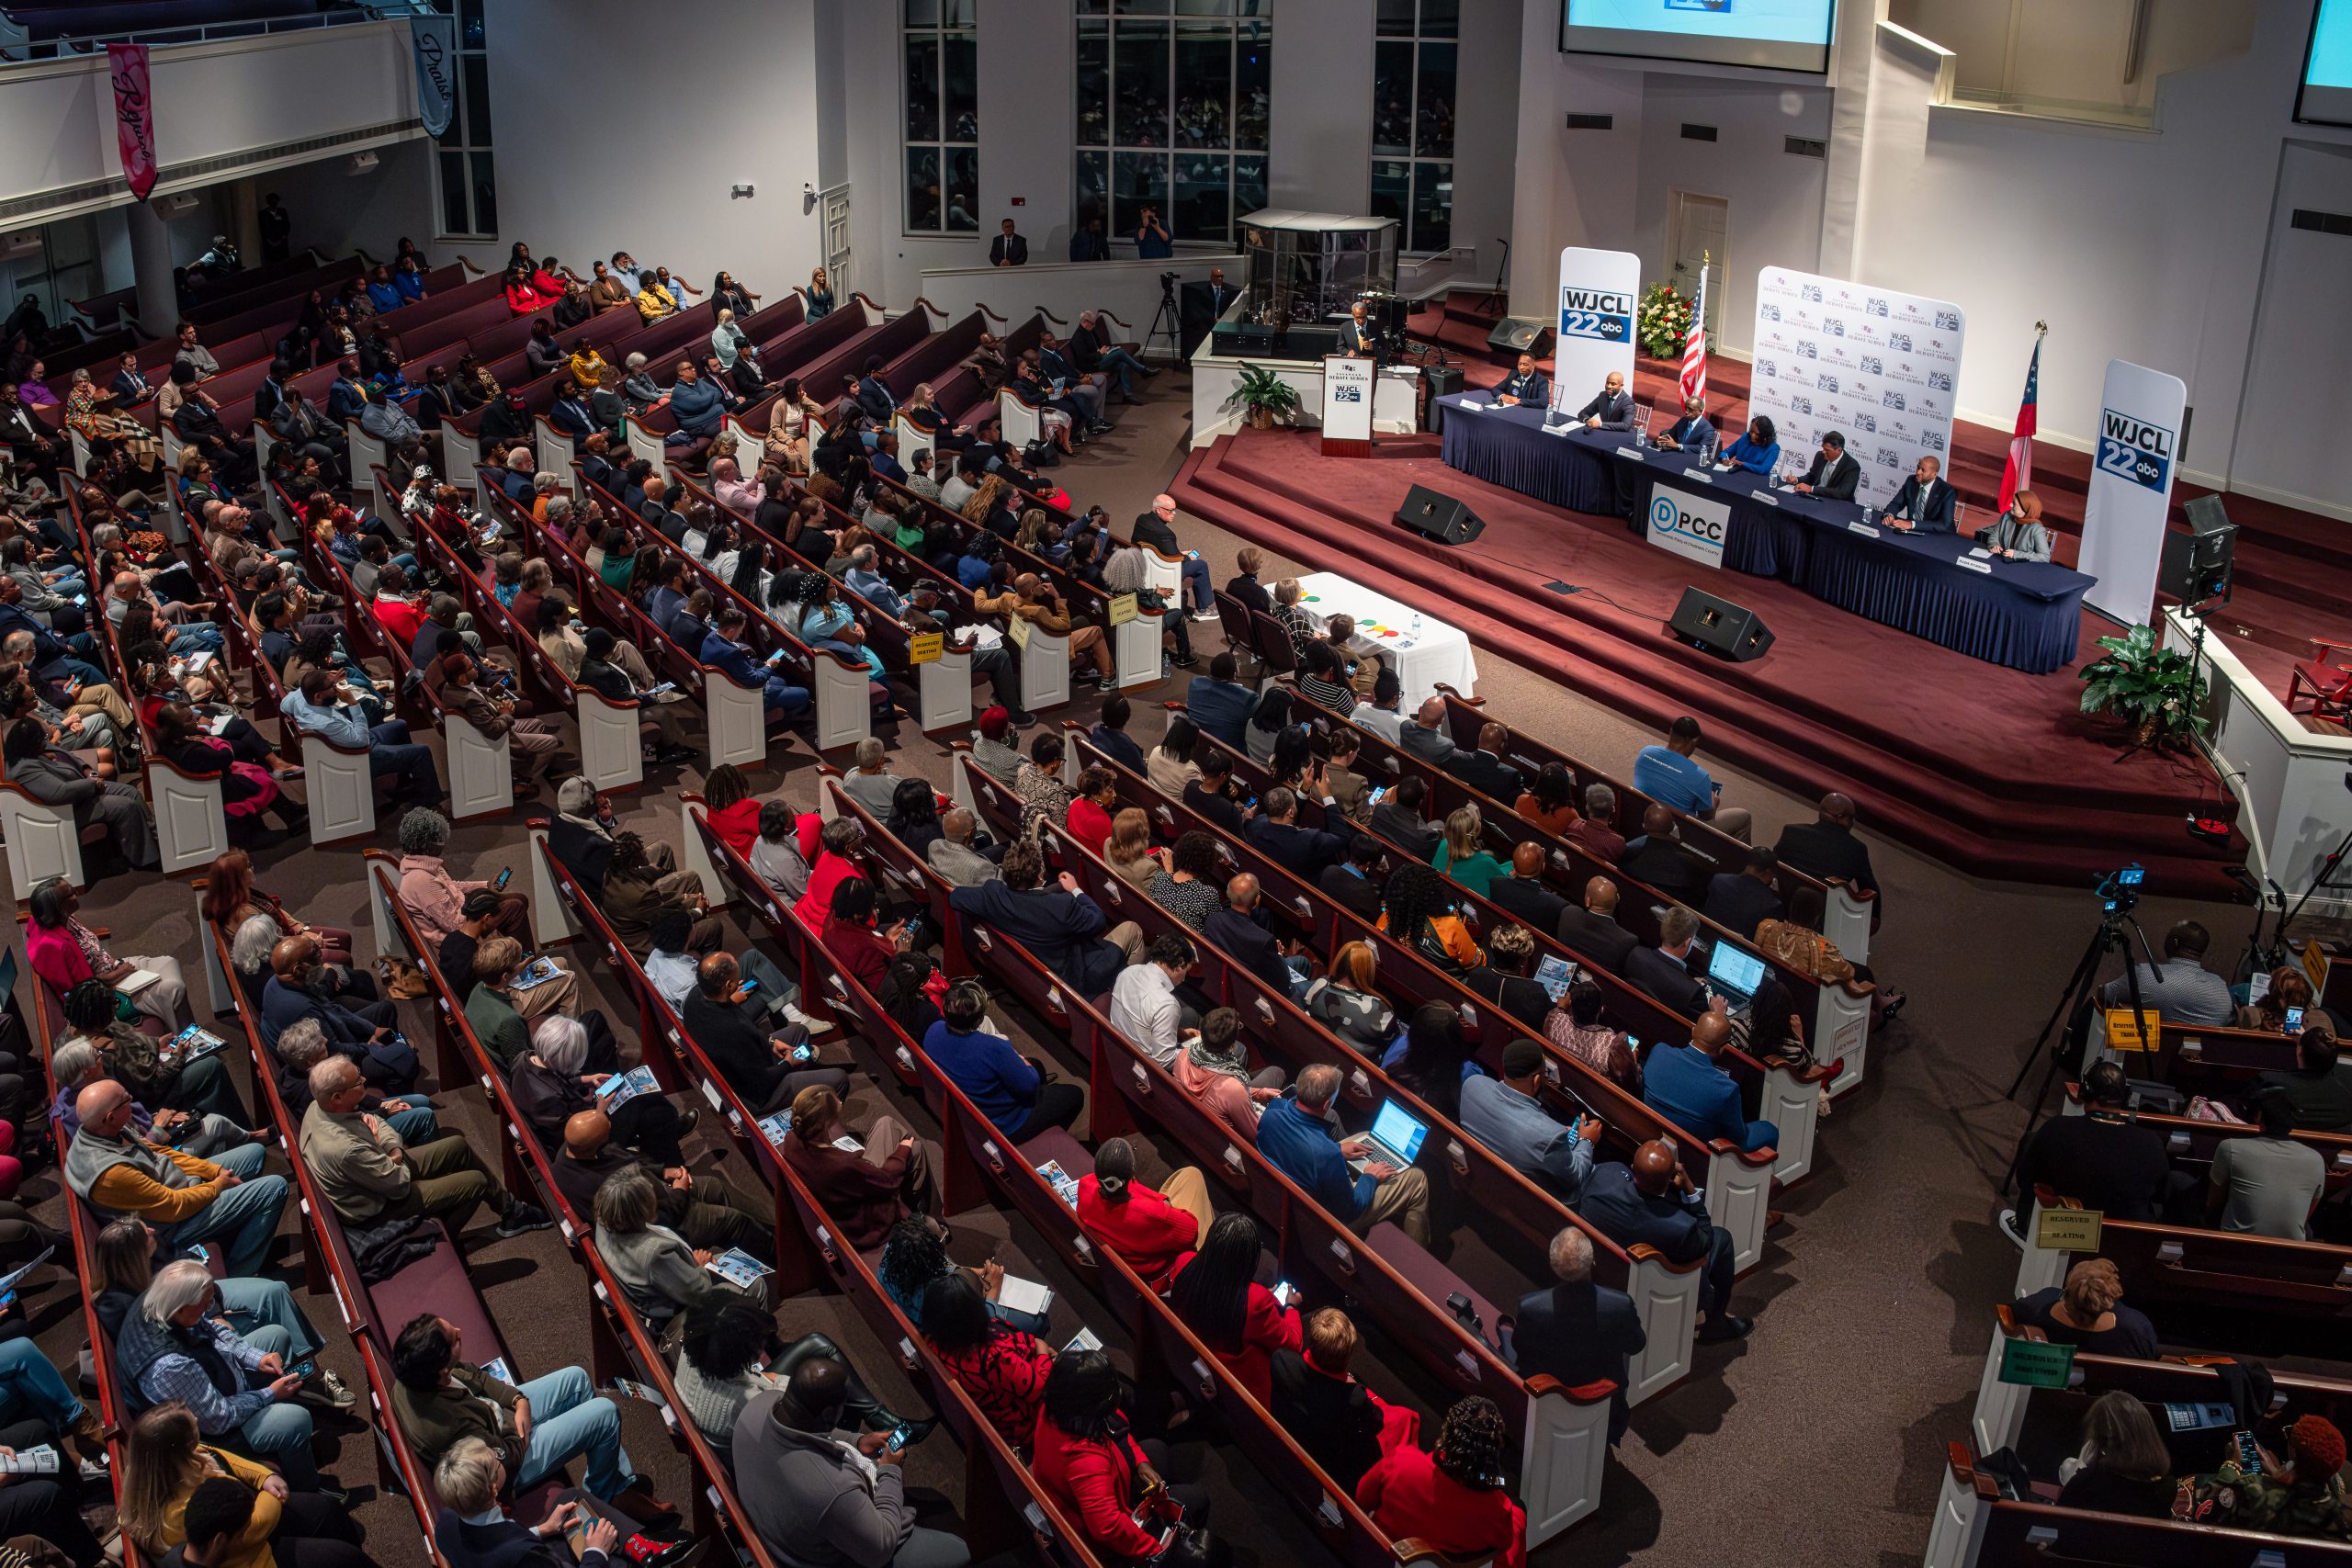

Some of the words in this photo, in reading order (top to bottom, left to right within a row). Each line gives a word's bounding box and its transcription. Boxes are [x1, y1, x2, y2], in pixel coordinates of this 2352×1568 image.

[415, 33, 452, 101] Praise
[1804, 284, 1822, 293] WJCL
[1566, 290, 1629, 315] WJCL
[1762, 303, 1781, 312] WJCL
[1868, 298, 1888, 307] WJCL
[1937, 311, 1959, 321] WJCL
[1566, 311, 1606, 338] 22
[1600, 321, 1623, 333] abc
[1825, 317, 1844, 327] WJCL
[1891, 333, 1912, 342] WJCL
[1798, 340, 1816, 349] WJCL
[1758, 358, 1776, 367] WJCL
[1862, 355, 1882, 365] WJCL
[1819, 374, 1838, 384] WJCL
[1930, 371, 1951, 381] WJCL
[1337, 385, 1360, 393] WJCL
[1337, 392, 1351, 401] 22
[1793, 395, 1812, 405] WJCL
[1885, 390, 1905, 400] WJCL
[1857, 412, 1876, 423] WJCL
[1924, 430, 1944, 441] WJCL
[2107, 413, 2167, 457] WJCL
[1879, 447, 1899, 458] WJCL
[2102, 441, 2140, 481] 22
[2136, 462, 2159, 479] abc
[1679, 511, 1722, 540] PCC
[2052, 1232, 2086, 1240] SEATING
